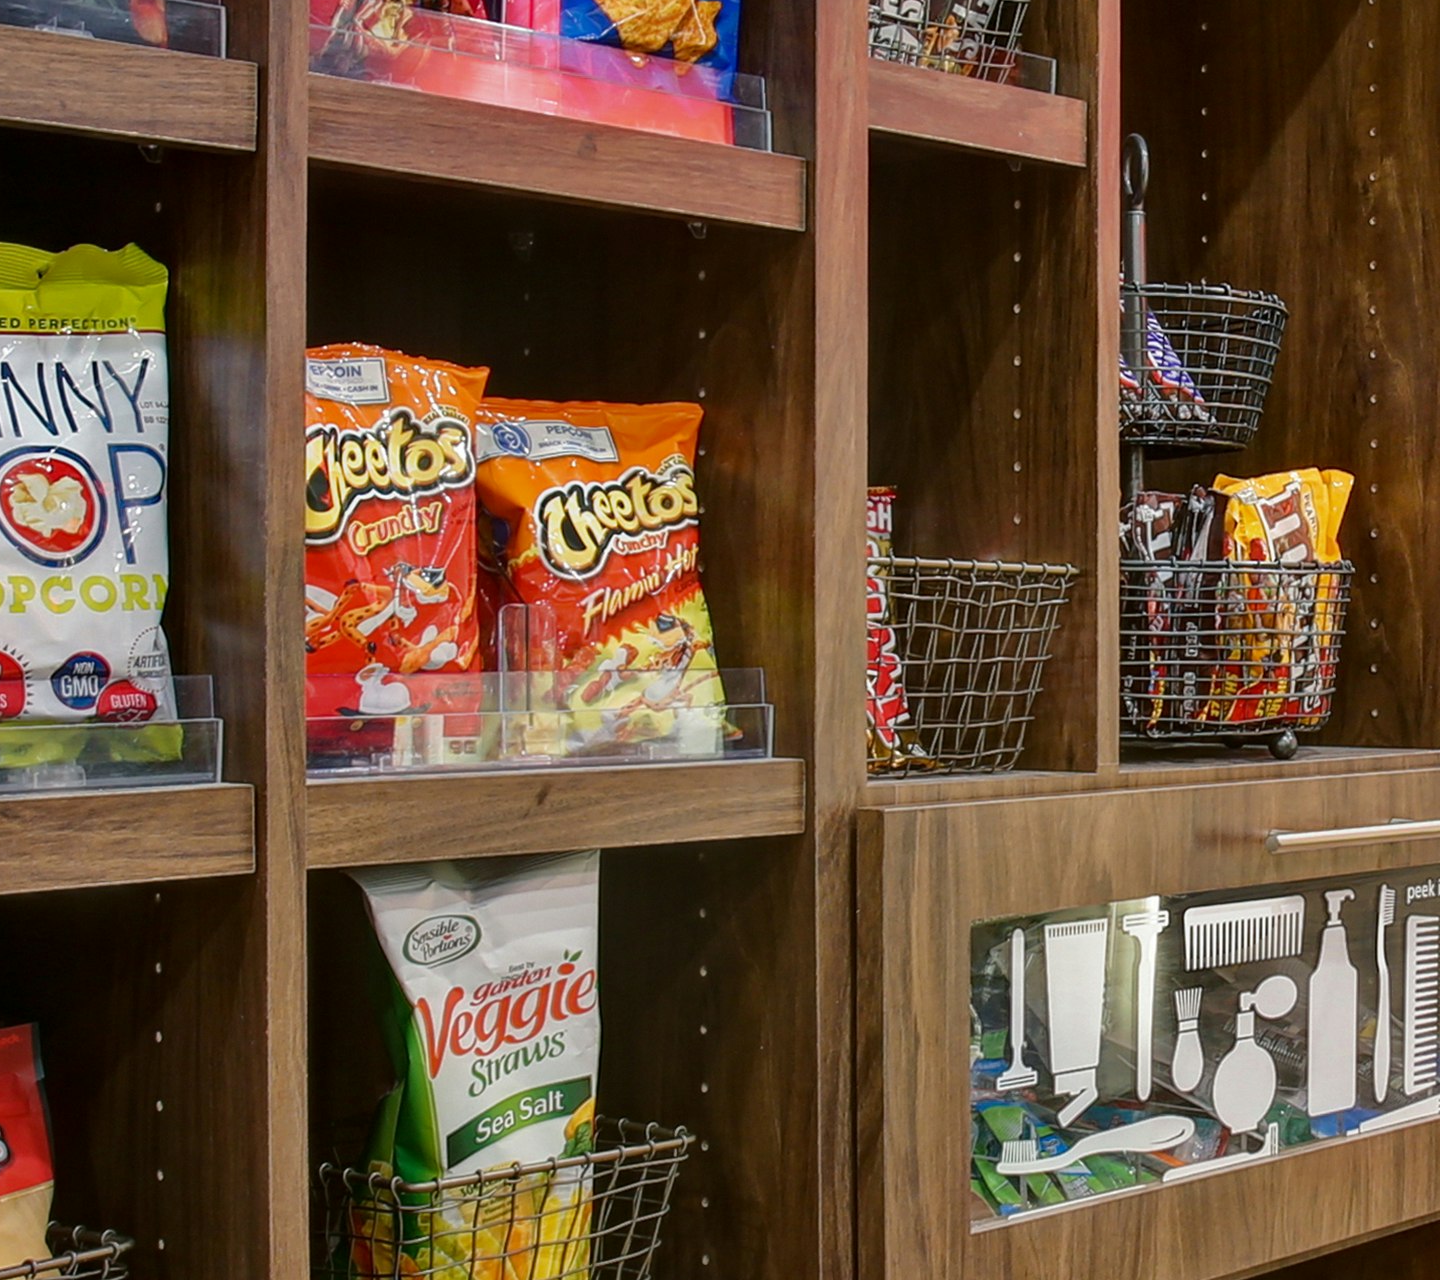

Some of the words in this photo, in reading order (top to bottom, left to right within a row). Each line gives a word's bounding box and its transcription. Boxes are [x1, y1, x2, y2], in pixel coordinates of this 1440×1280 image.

[29, 317, 129, 330] PERFECTION
[306, 414, 473, 533] Cheetos
[348, 501, 442, 556] Crunchy
[544, 475, 698, 570] Cheetos
[613, 531, 666, 554] Crunchy
[61, 675, 99, 698] GMO
[110, 693, 148, 709] GLUTEN
[1406, 879, 1435, 905] peek
[412, 919, 459, 950] Sensible
[420, 933, 472, 961] Portions
[470, 966, 553, 1007] garden
[416, 963, 597, 1080] Veggie
[468, 1030, 565, 1099] Straws
[475, 1109, 517, 1145] Sea
[518, 1089, 564, 1128] Salt
